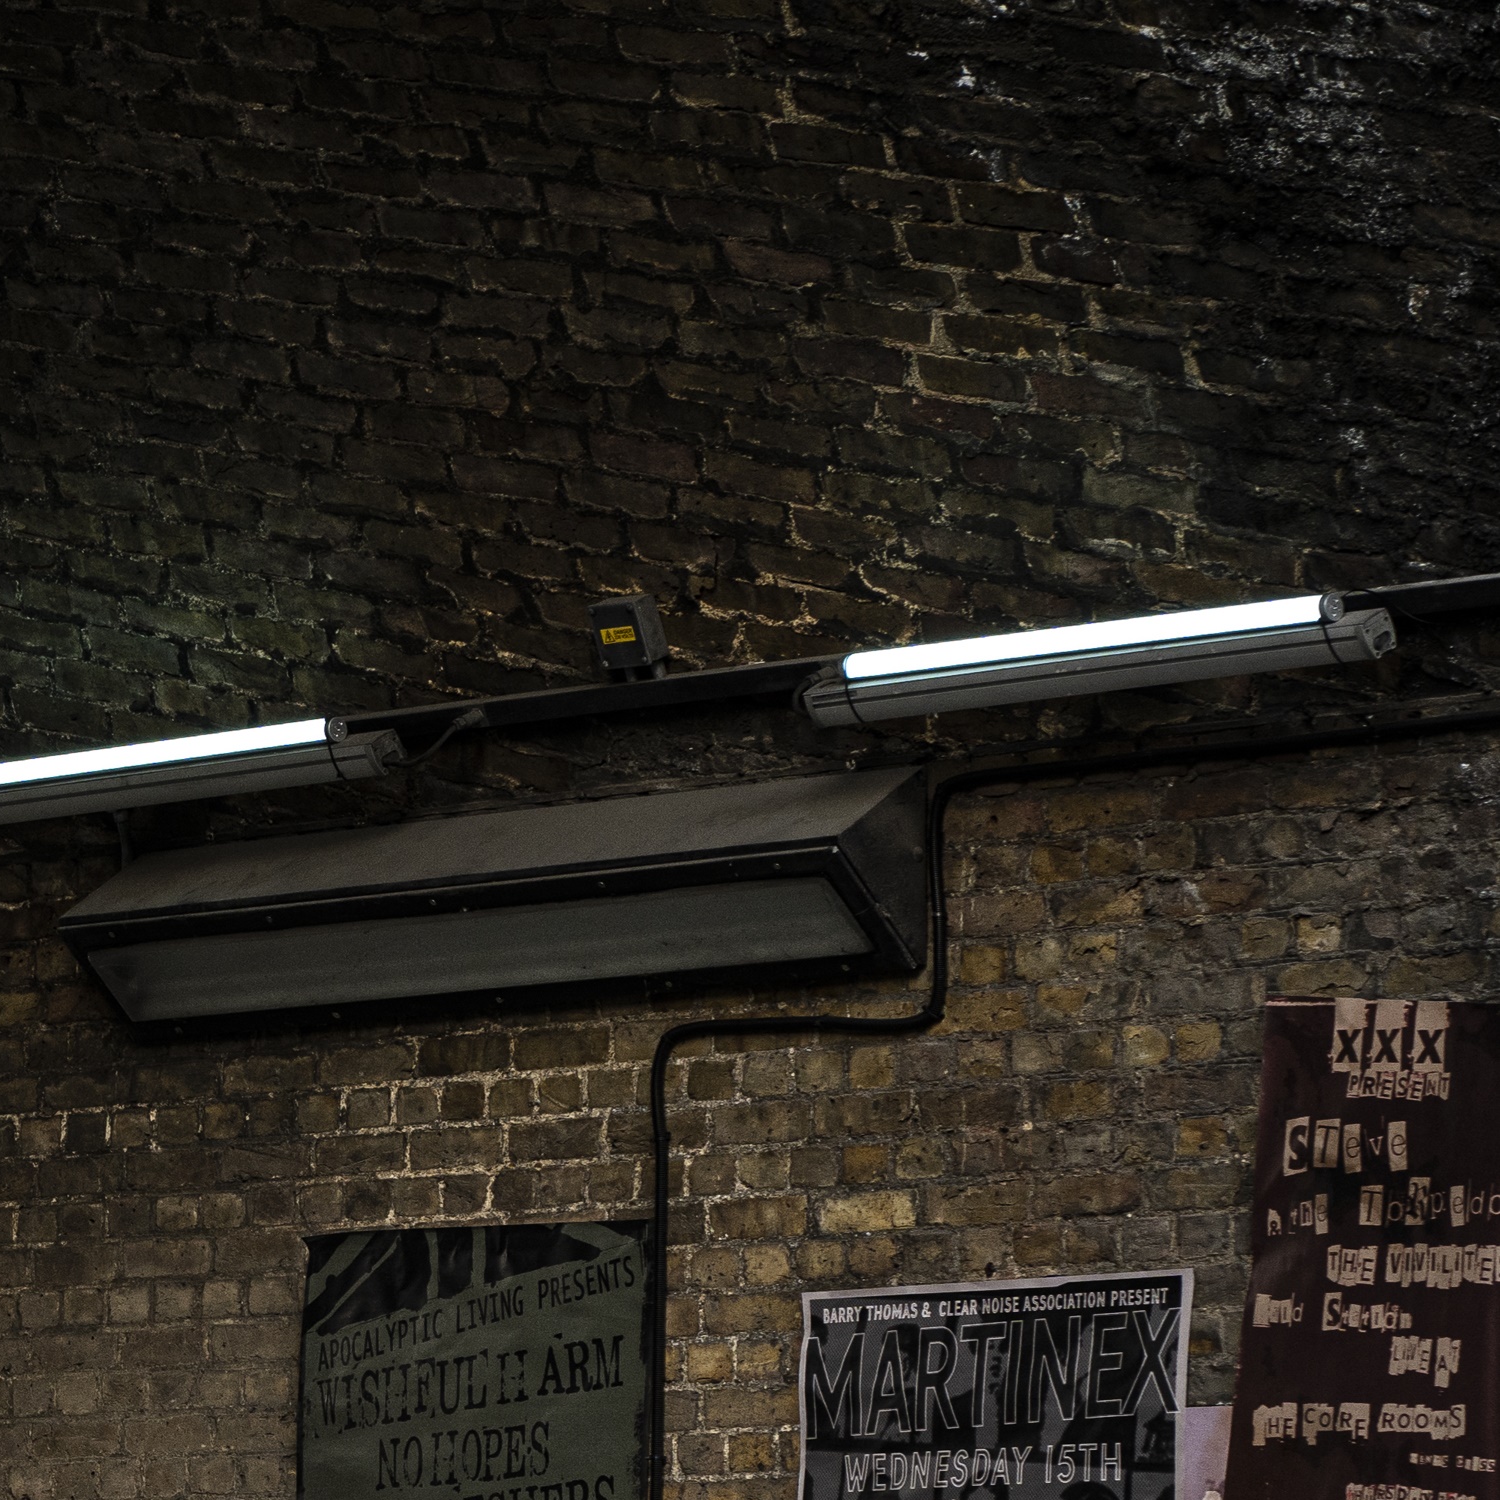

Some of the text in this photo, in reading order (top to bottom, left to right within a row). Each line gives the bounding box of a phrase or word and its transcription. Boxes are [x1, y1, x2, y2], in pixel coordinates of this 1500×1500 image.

[1349, 1074, 1450, 1100] PRESENT
[1289, 1198, 1329, 1227] the
[1328, 1250, 1500, 1284] THE VIVILITE
[317, 1255, 636, 1372] APOCALYPTIC LIVING PRESENTS
[822, 1286, 1170, 1325] BARRY THOMAS & CLEAR NOISE ASSOCIATION PRESENT
[316, 1350, 490, 1431] WISHFUL
[805, 1307, 1182, 1441] MARTINEX
[1381, 1406, 1463, 1430] ROOMS
[374, 1420, 551, 1491] NO HOPES
[844, 1442, 1122, 1493] WEDNESDAY 15TH
